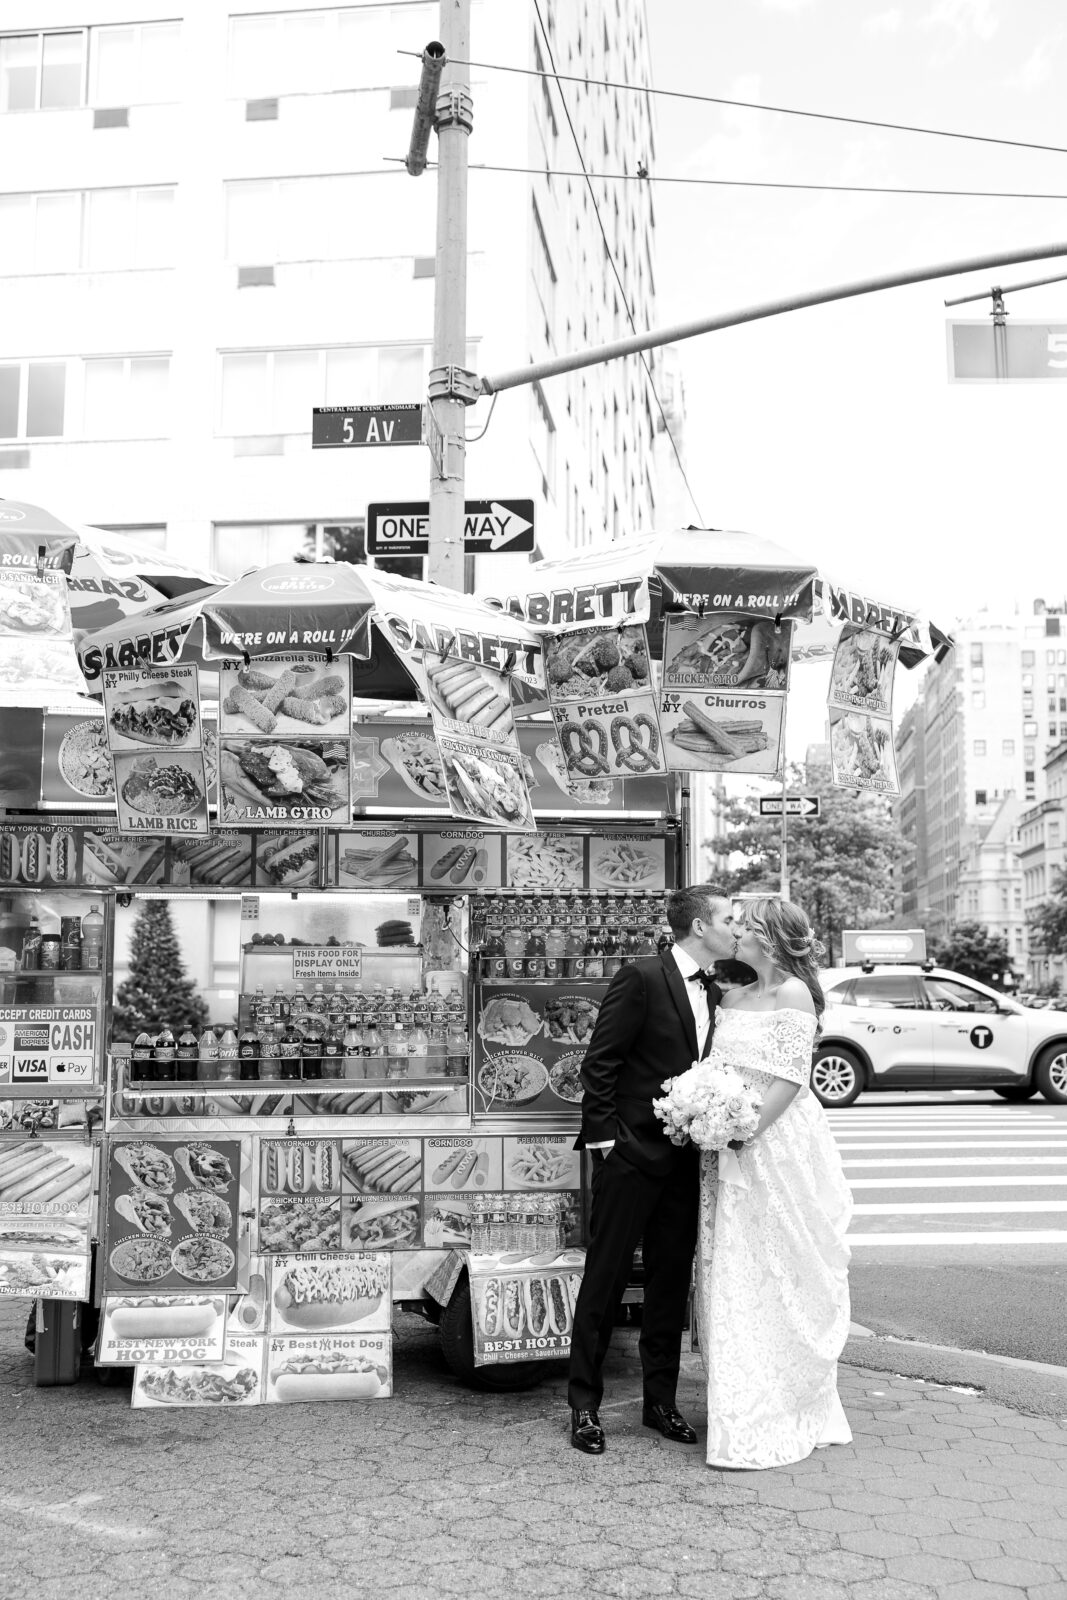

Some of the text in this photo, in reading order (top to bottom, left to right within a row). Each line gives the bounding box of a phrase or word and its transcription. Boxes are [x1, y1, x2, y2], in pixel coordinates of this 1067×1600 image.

[342, 416, 395, 443] 5 Av
[382, 516, 512, 539] ONE WAY
[713, 594, 732, 607] ON
[734, 594, 744, 607] A
[747, 595, 780, 608] ROLL
[220, 631, 263, 645] WE'RE
[266, 631, 287, 645] ON
[289, 631, 299, 644] A
[302, 629, 336, 644] ROLL
[308, 653, 340, 663] Stics
[222, 661, 241, 671] NY
[119, 672, 140, 682] Philly
[141, 670, 169, 680] Cheese
[170, 668, 193, 678] Steak
[667, 673, 739, 684] CHICKEN GYRO
[105, 680, 117, 688] NY
[662, 703, 682, 713] NY
[704, 695, 767, 710] Churros
[577, 700, 629, 718] Pretzel
[555, 714, 570, 723] NY
[63, 719, 96, 740] CHICKEN
[245, 806, 333, 820] LAMB GYRO
[17, 825, 39, 833] YORK
[128, 816, 198, 831] LAMB RICE
[440, 831, 485, 839] CORN DOG
[294, 958, 360, 968] DISPLAY ONLY
[495, 961, 504, 970] G
[512, 960, 522, 971] G
[528, 961, 537, 971] G
[295, 969, 359, 977] Fresh Items Inside
[29, 1009, 61, 1020] CREDIT
[62, 1009, 92, 1020] CARDS
[51, 1024, 94, 1051] CASH
[974, 1029, 989, 1047] T
[482, 1050, 510, 1063] CHICKEN
[529, 1053, 544, 1063] RICE
[17, 1059, 47, 1073] VISA
[67, 1062, 87, 1075] Pay
[428, 1138, 473, 1147] CORN DOG
[270, 1196, 303, 1204] CHICKEN
[350, 1195, 377, 1203] ITALIAN
[23, 1202, 49, 1213] HOT
[51, 1202, 78, 1213] DOG
[114, 1233, 140, 1246] CHICKEN
[177, 1233, 193, 1242] LAMB
[295, 1252, 377, 1261] Chili Cheese Dog
[275, 1260, 288, 1268] NY
[107, 1337, 217, 1349] BEST NEW YORK
[229, 1339, 258, 1348] Steak
[271, 1344, 285, 1352] NY
[288, 1340, 318, 1349] Best
[333, 1339, 355, 1348] Hot
[359, 1339, 384, 1349] Dog
[483, 1339, 522, 1352] BEST
[525, 1337, 557, 1349] HOT
[116, 1348, 208, 1361] HOT DOG
[483, 1348, 571, 1361] Chili Cheese Sauerkraut
